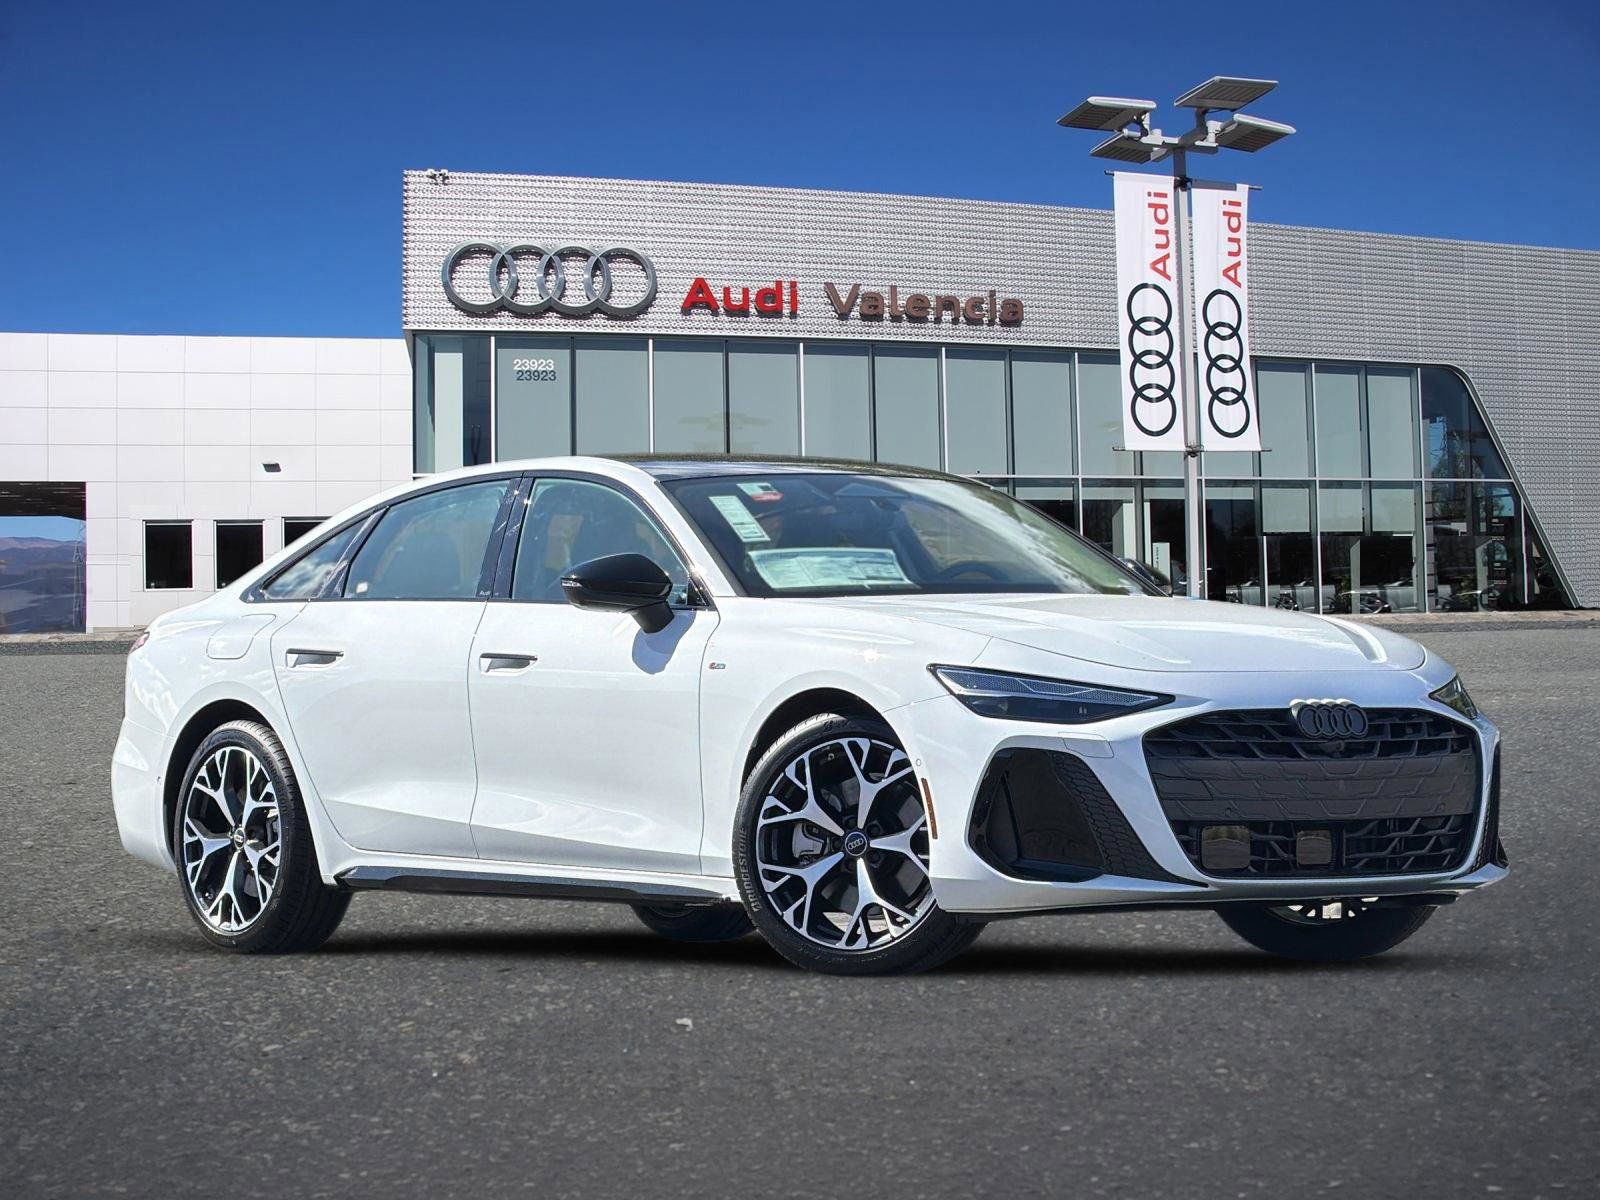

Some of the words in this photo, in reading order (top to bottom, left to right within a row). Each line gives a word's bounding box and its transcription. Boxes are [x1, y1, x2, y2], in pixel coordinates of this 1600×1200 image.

[1147, 191, 1171, 281] Audi
[1222, 199, 1242, 288] Audi
[681, 277, 798, 318] Audi
[823, 281, 1024, 327] Valencia
[513, 359, 554, 370] 23923
[516, 370, 557, 381] 23923
